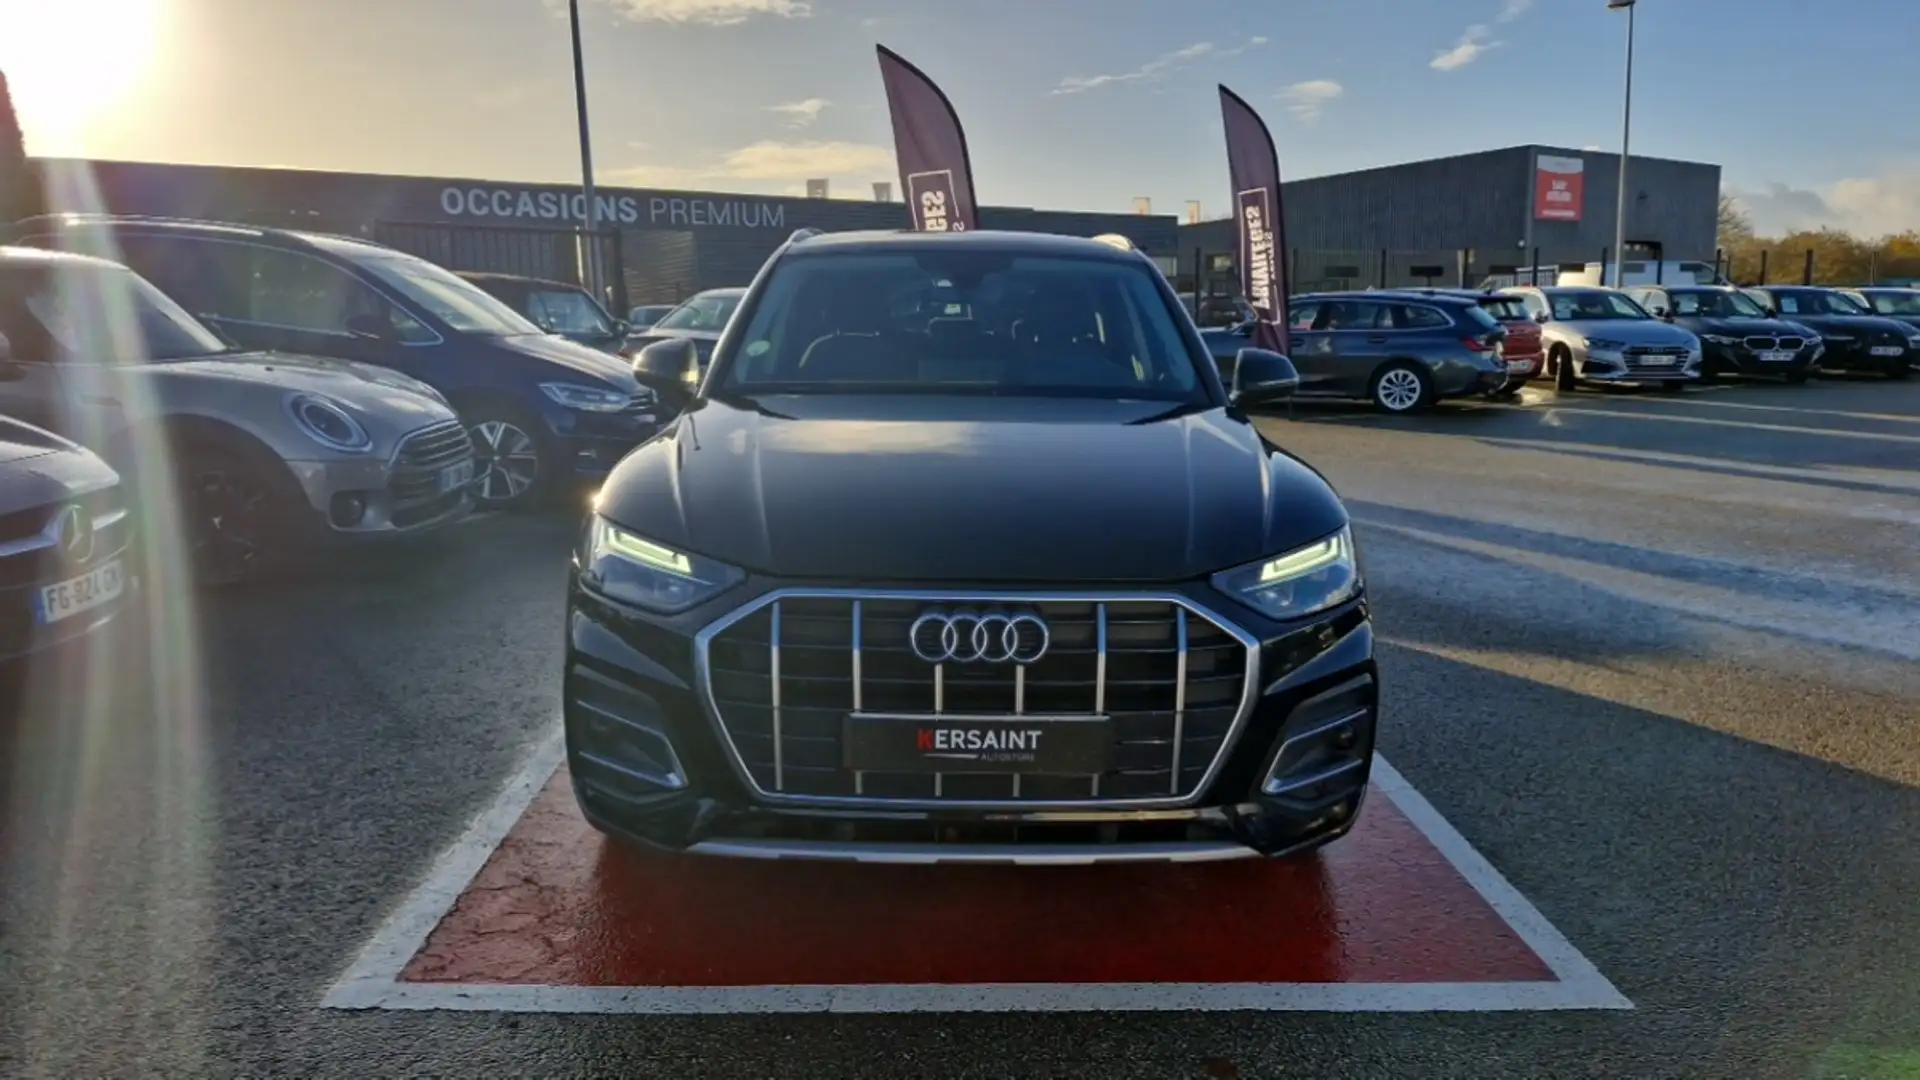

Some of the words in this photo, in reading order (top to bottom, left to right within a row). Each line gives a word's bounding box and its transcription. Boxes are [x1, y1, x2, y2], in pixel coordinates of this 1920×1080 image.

[440, 187, 638, 222] OCCASIONS
[651, 198, 785, 228] PREMIUM
[917, 729, 1043, 750] KERSAINT
